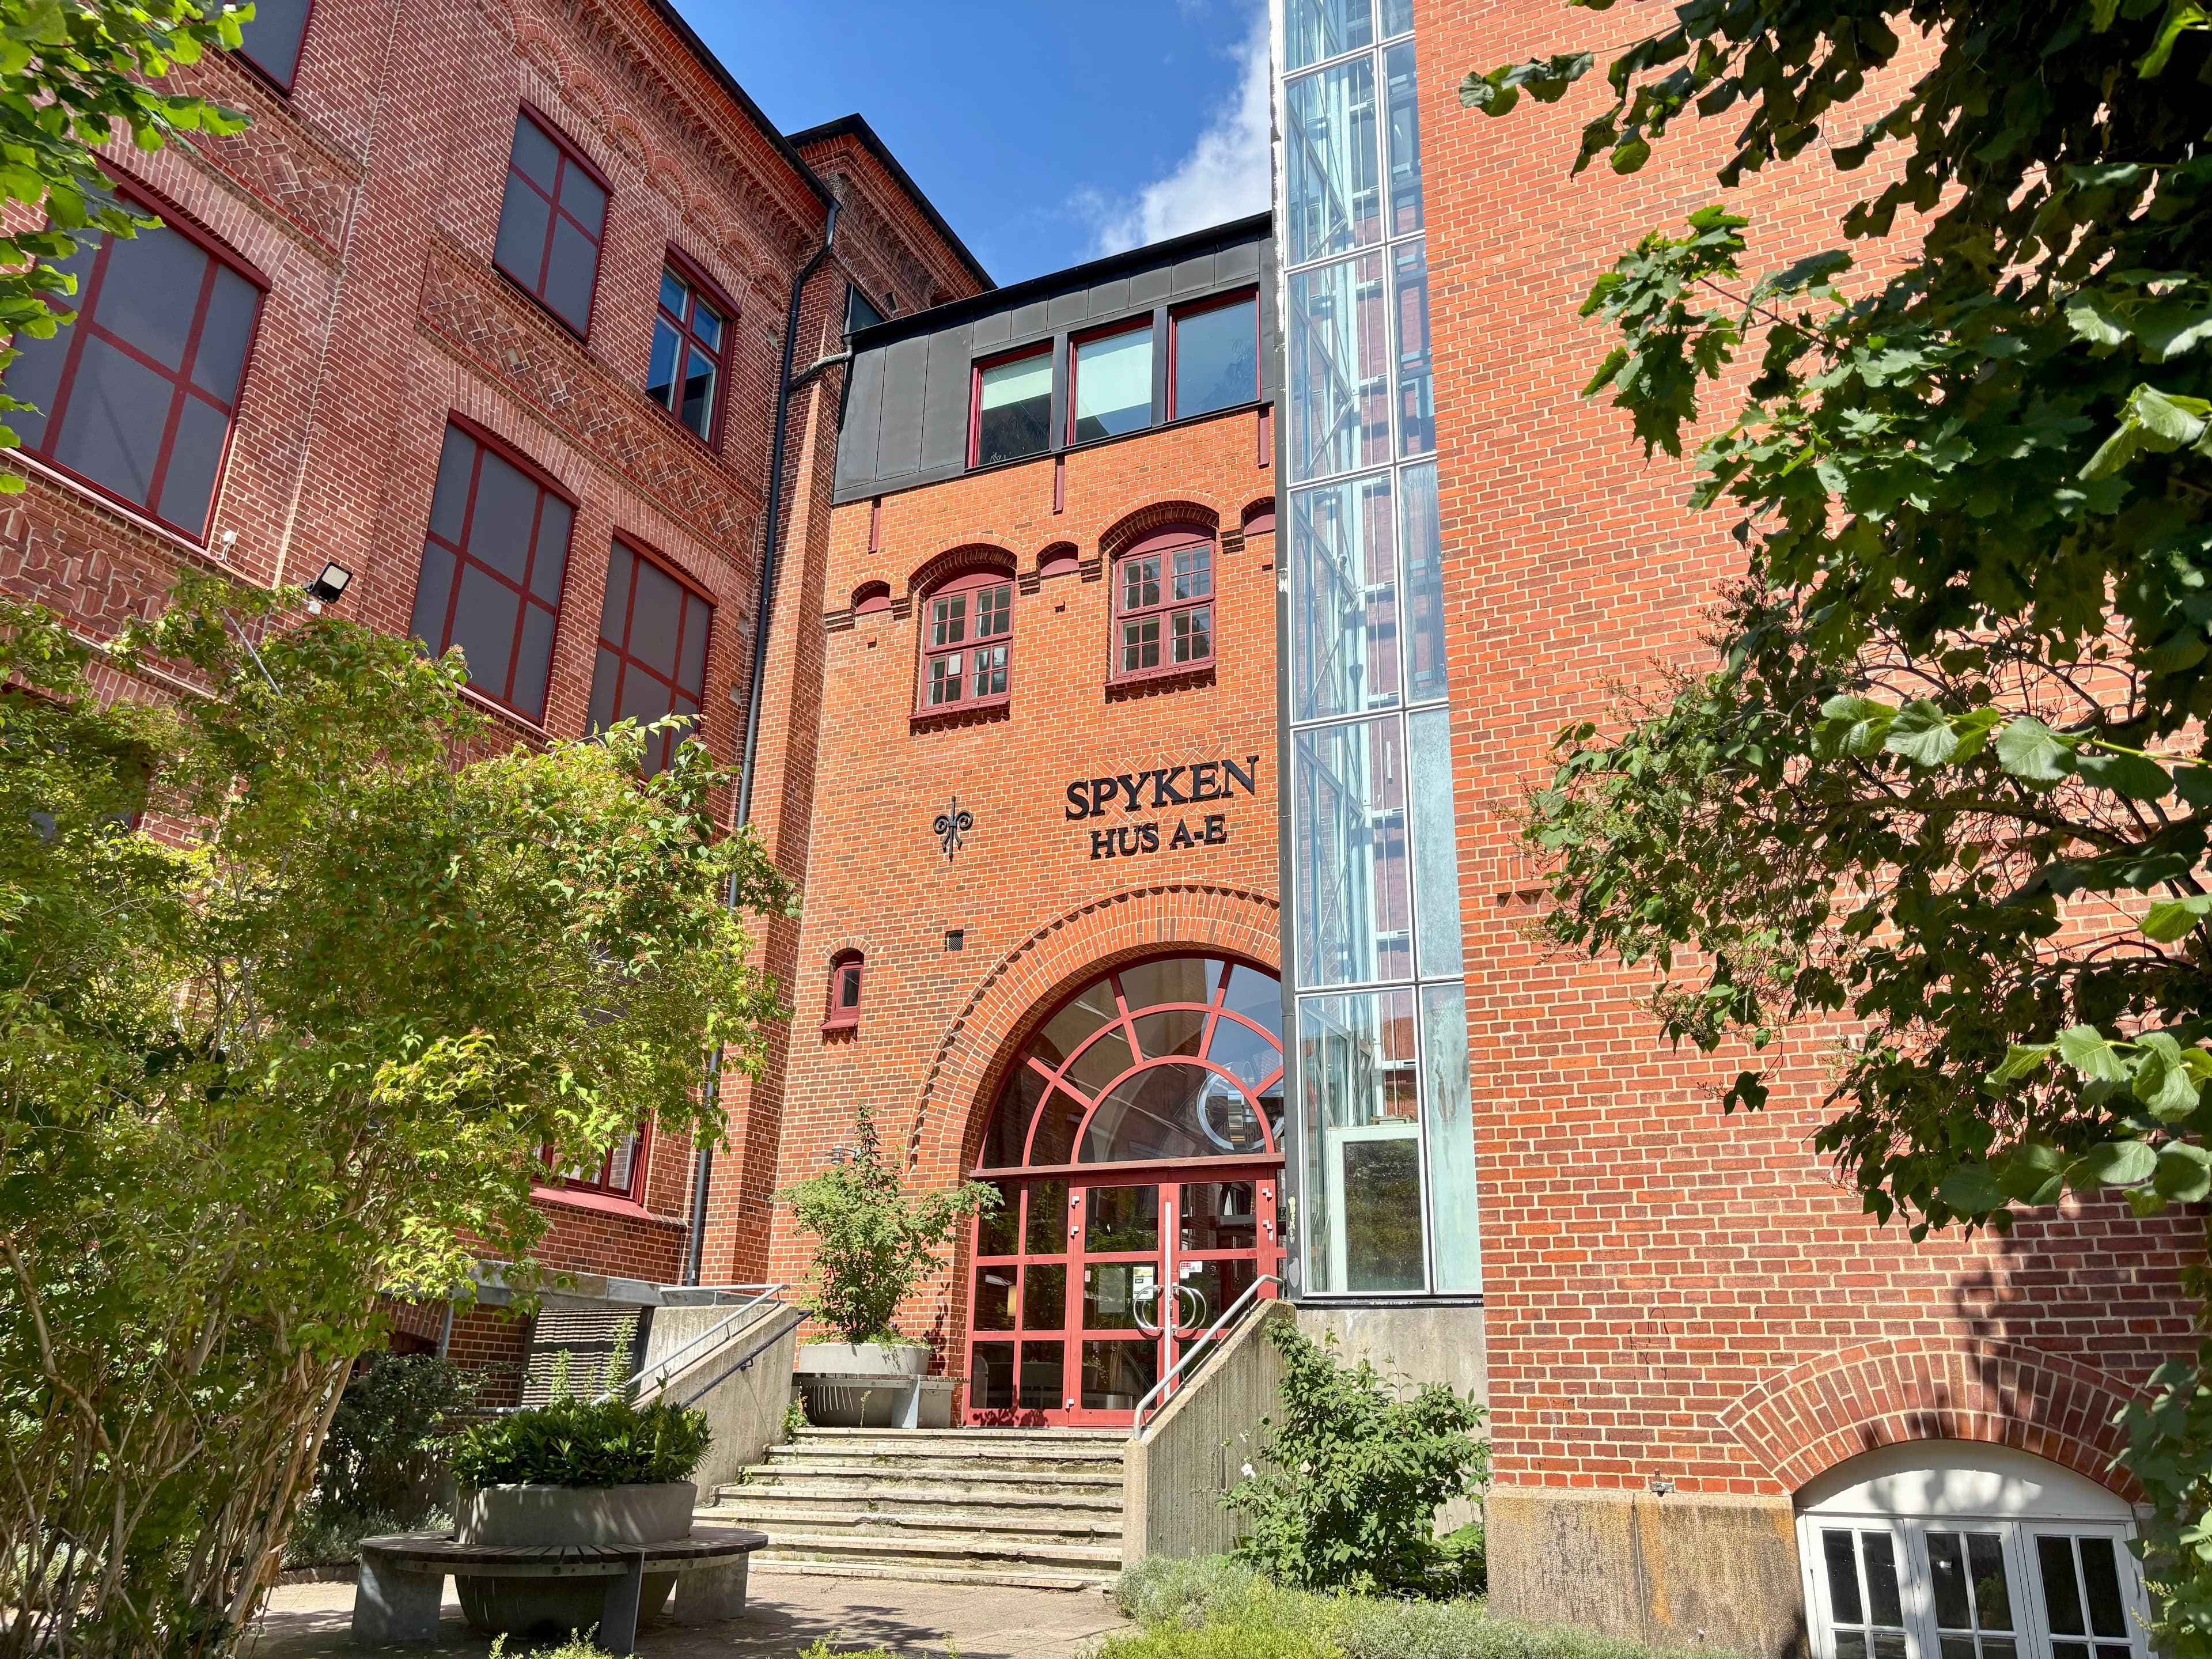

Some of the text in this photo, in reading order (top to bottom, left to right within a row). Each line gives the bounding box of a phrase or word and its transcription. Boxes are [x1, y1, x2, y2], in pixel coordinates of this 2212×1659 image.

[1065, 755, 1259, 821] SPYKEN
[1090, 813, 1227, 860] HUS A-E
